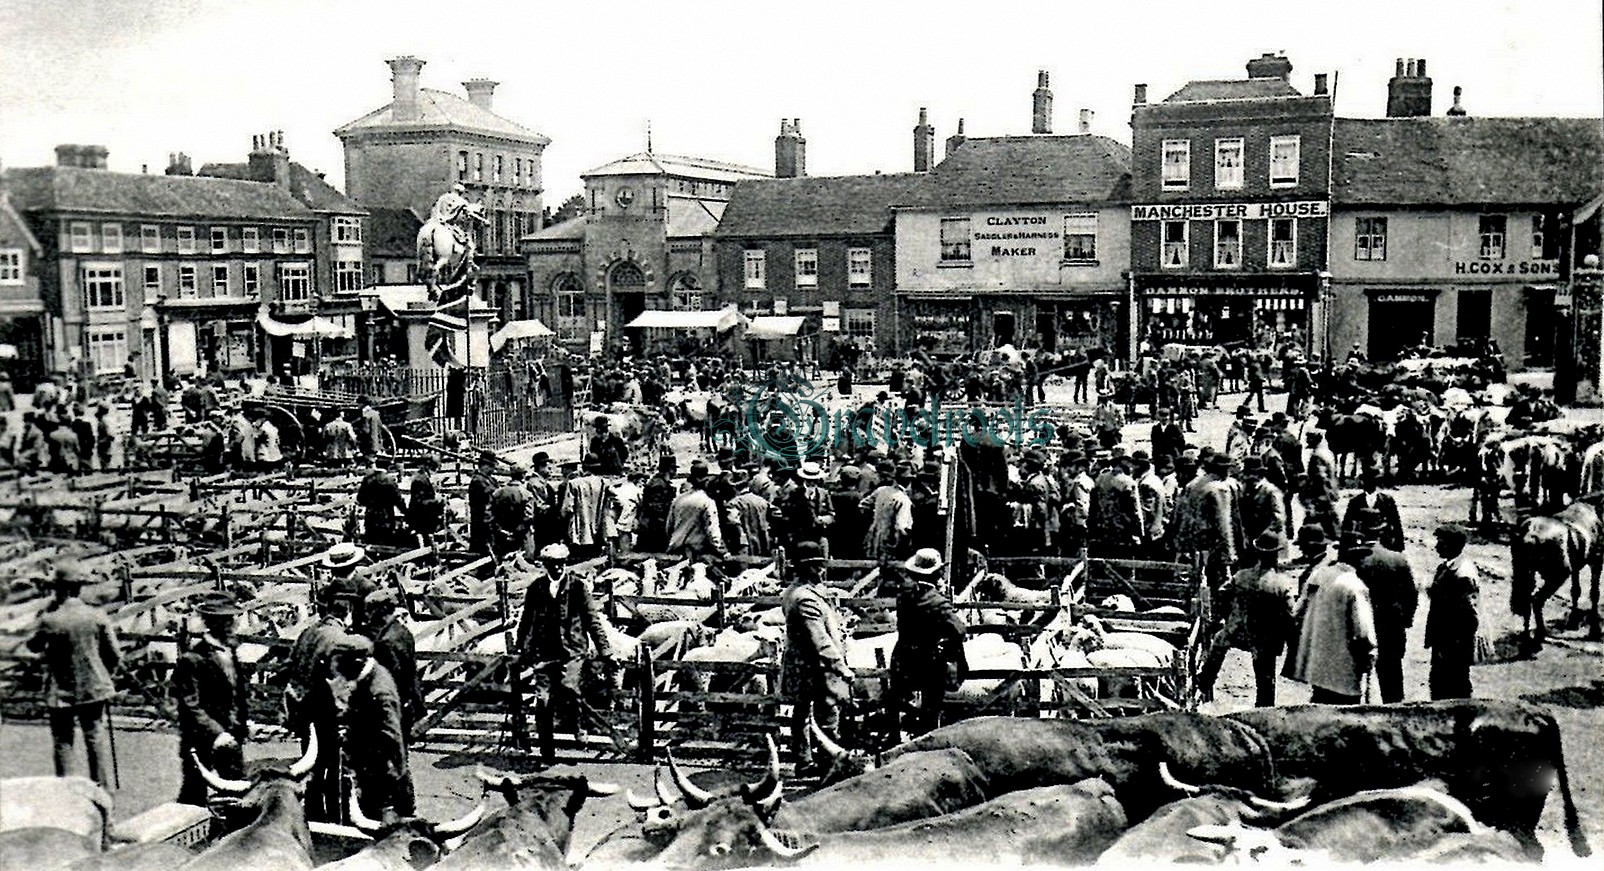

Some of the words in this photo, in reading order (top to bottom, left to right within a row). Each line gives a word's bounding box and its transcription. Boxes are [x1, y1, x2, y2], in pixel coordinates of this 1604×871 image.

[1134, 204, 1247, 218] MANCHESTER
[1260, 202, 1326, 217] HOUSE.
[987, 216, 1047, 226] CLAYTON
[991, 246, 1036, 256] MAKER
[1506, 264, 1515, 274] &
